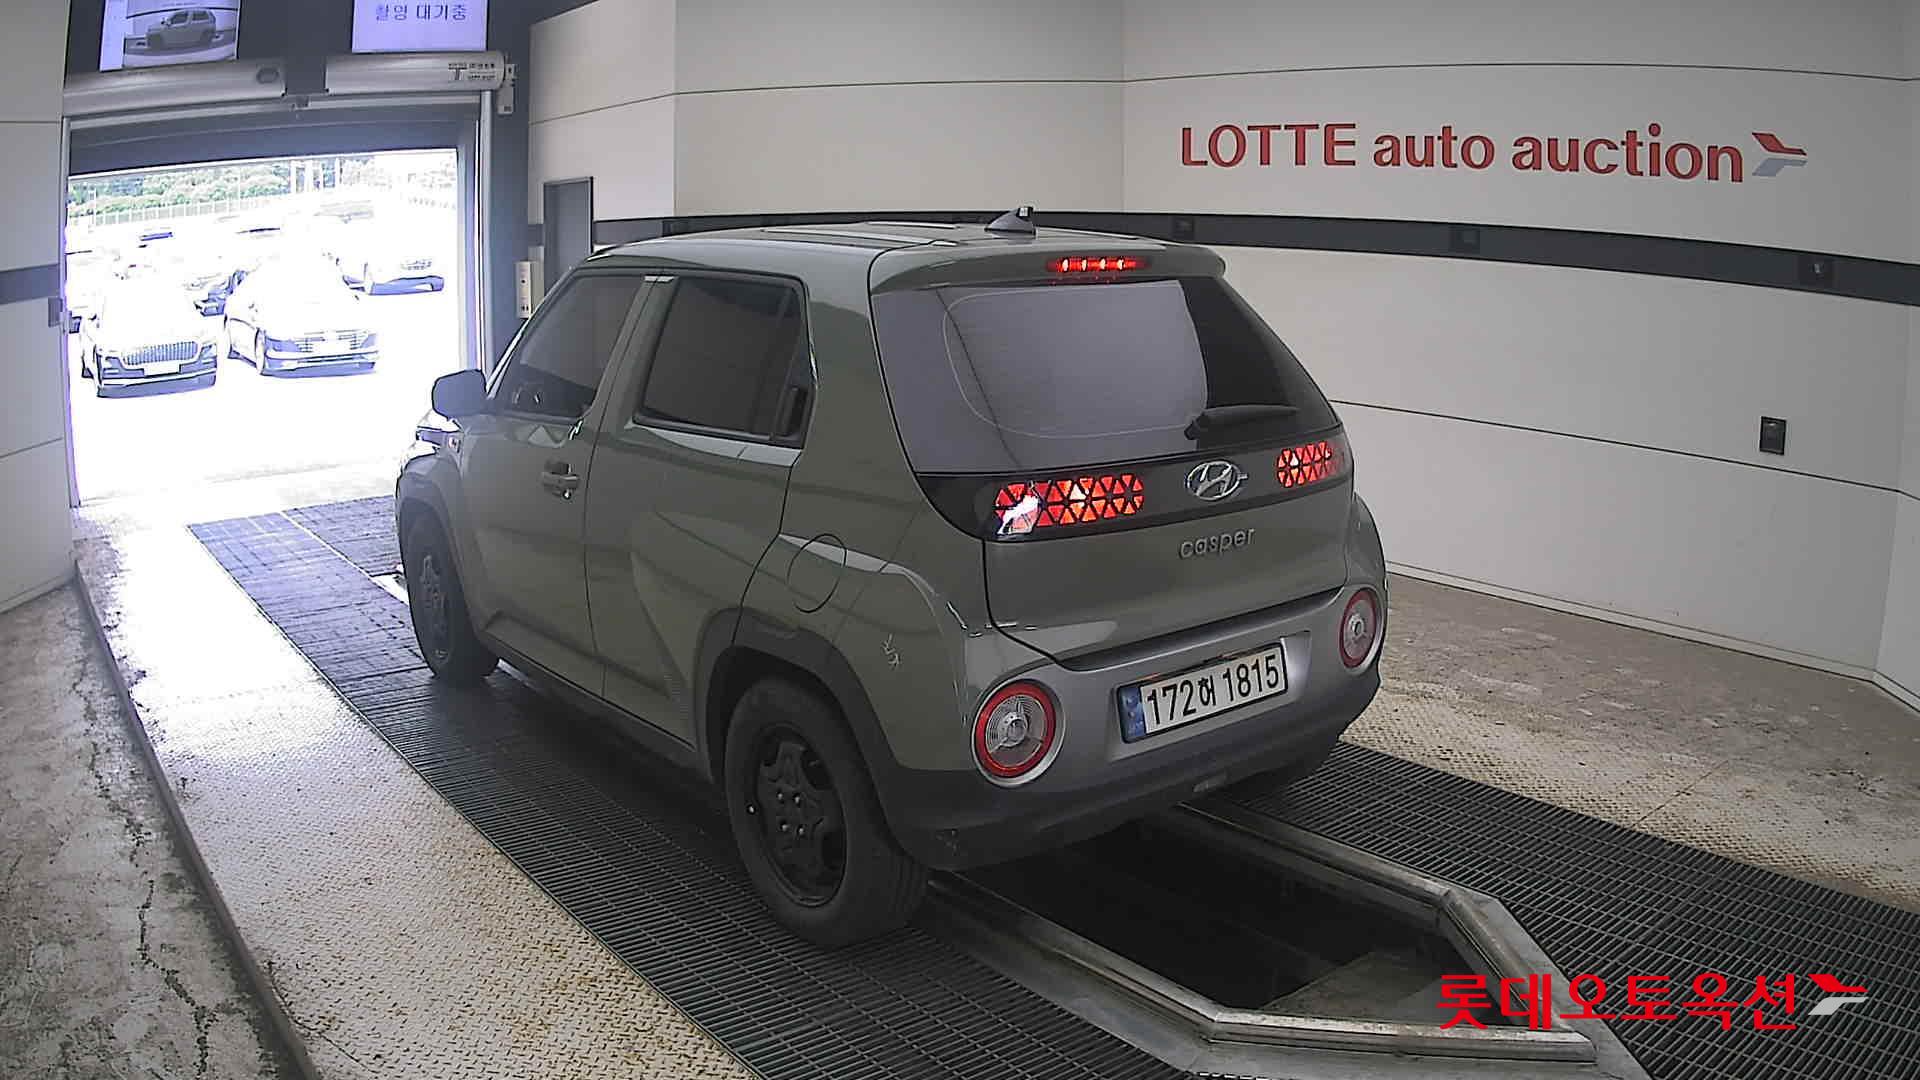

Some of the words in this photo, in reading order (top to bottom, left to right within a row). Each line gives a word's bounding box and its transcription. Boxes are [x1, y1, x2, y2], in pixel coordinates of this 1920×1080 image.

[416, 4, 467, 21] 대기중
[1182, 123, 1357, 168] LOTTE
[1373, 125, 1496, 169] auto
[1511, 123, 1744, 182] auction
[1179, 528, 1256, 559] casper
[1146, 674, 1217, 725] 172허
[1222, 654, 1280, 702] 1815
